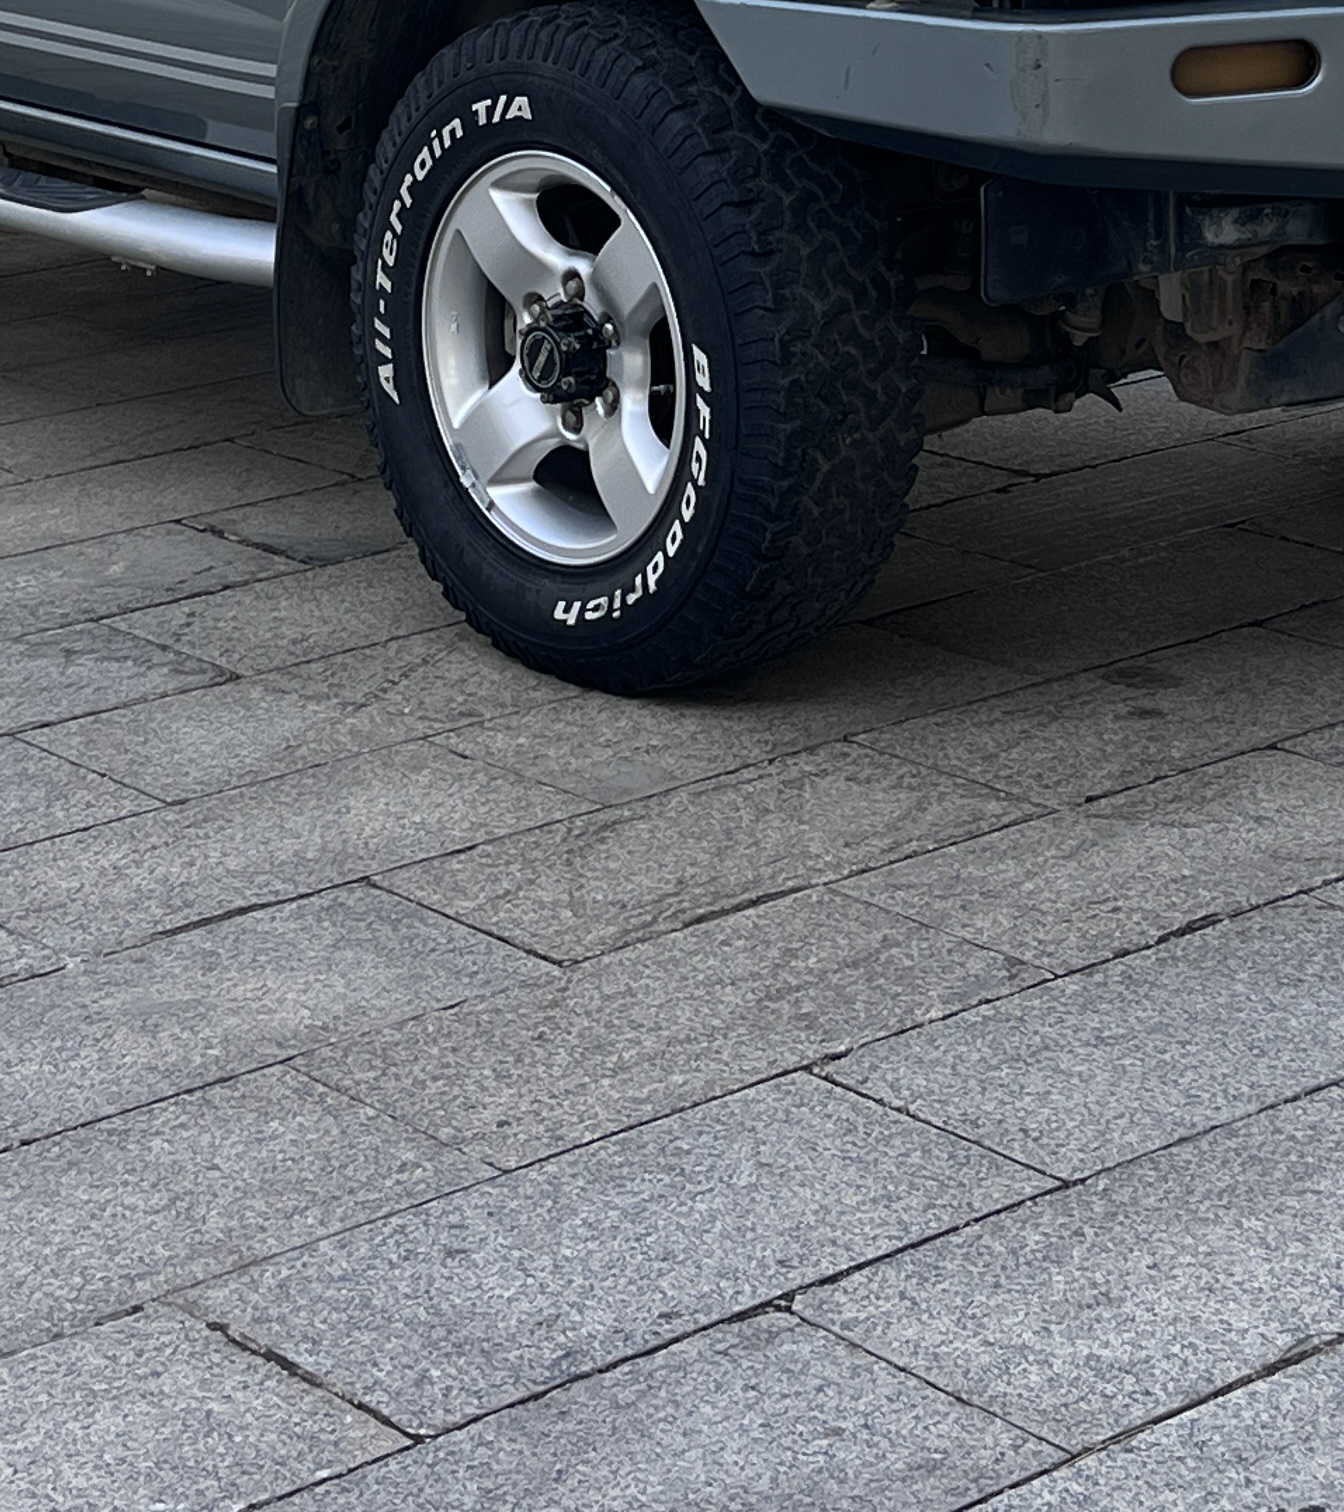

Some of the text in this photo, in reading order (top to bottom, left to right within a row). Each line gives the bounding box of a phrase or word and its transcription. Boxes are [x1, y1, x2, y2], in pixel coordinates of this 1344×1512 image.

[374, 94, 534, 406] All-Terrain T/A
[553, 343, 713, 627] BFGoodrich
